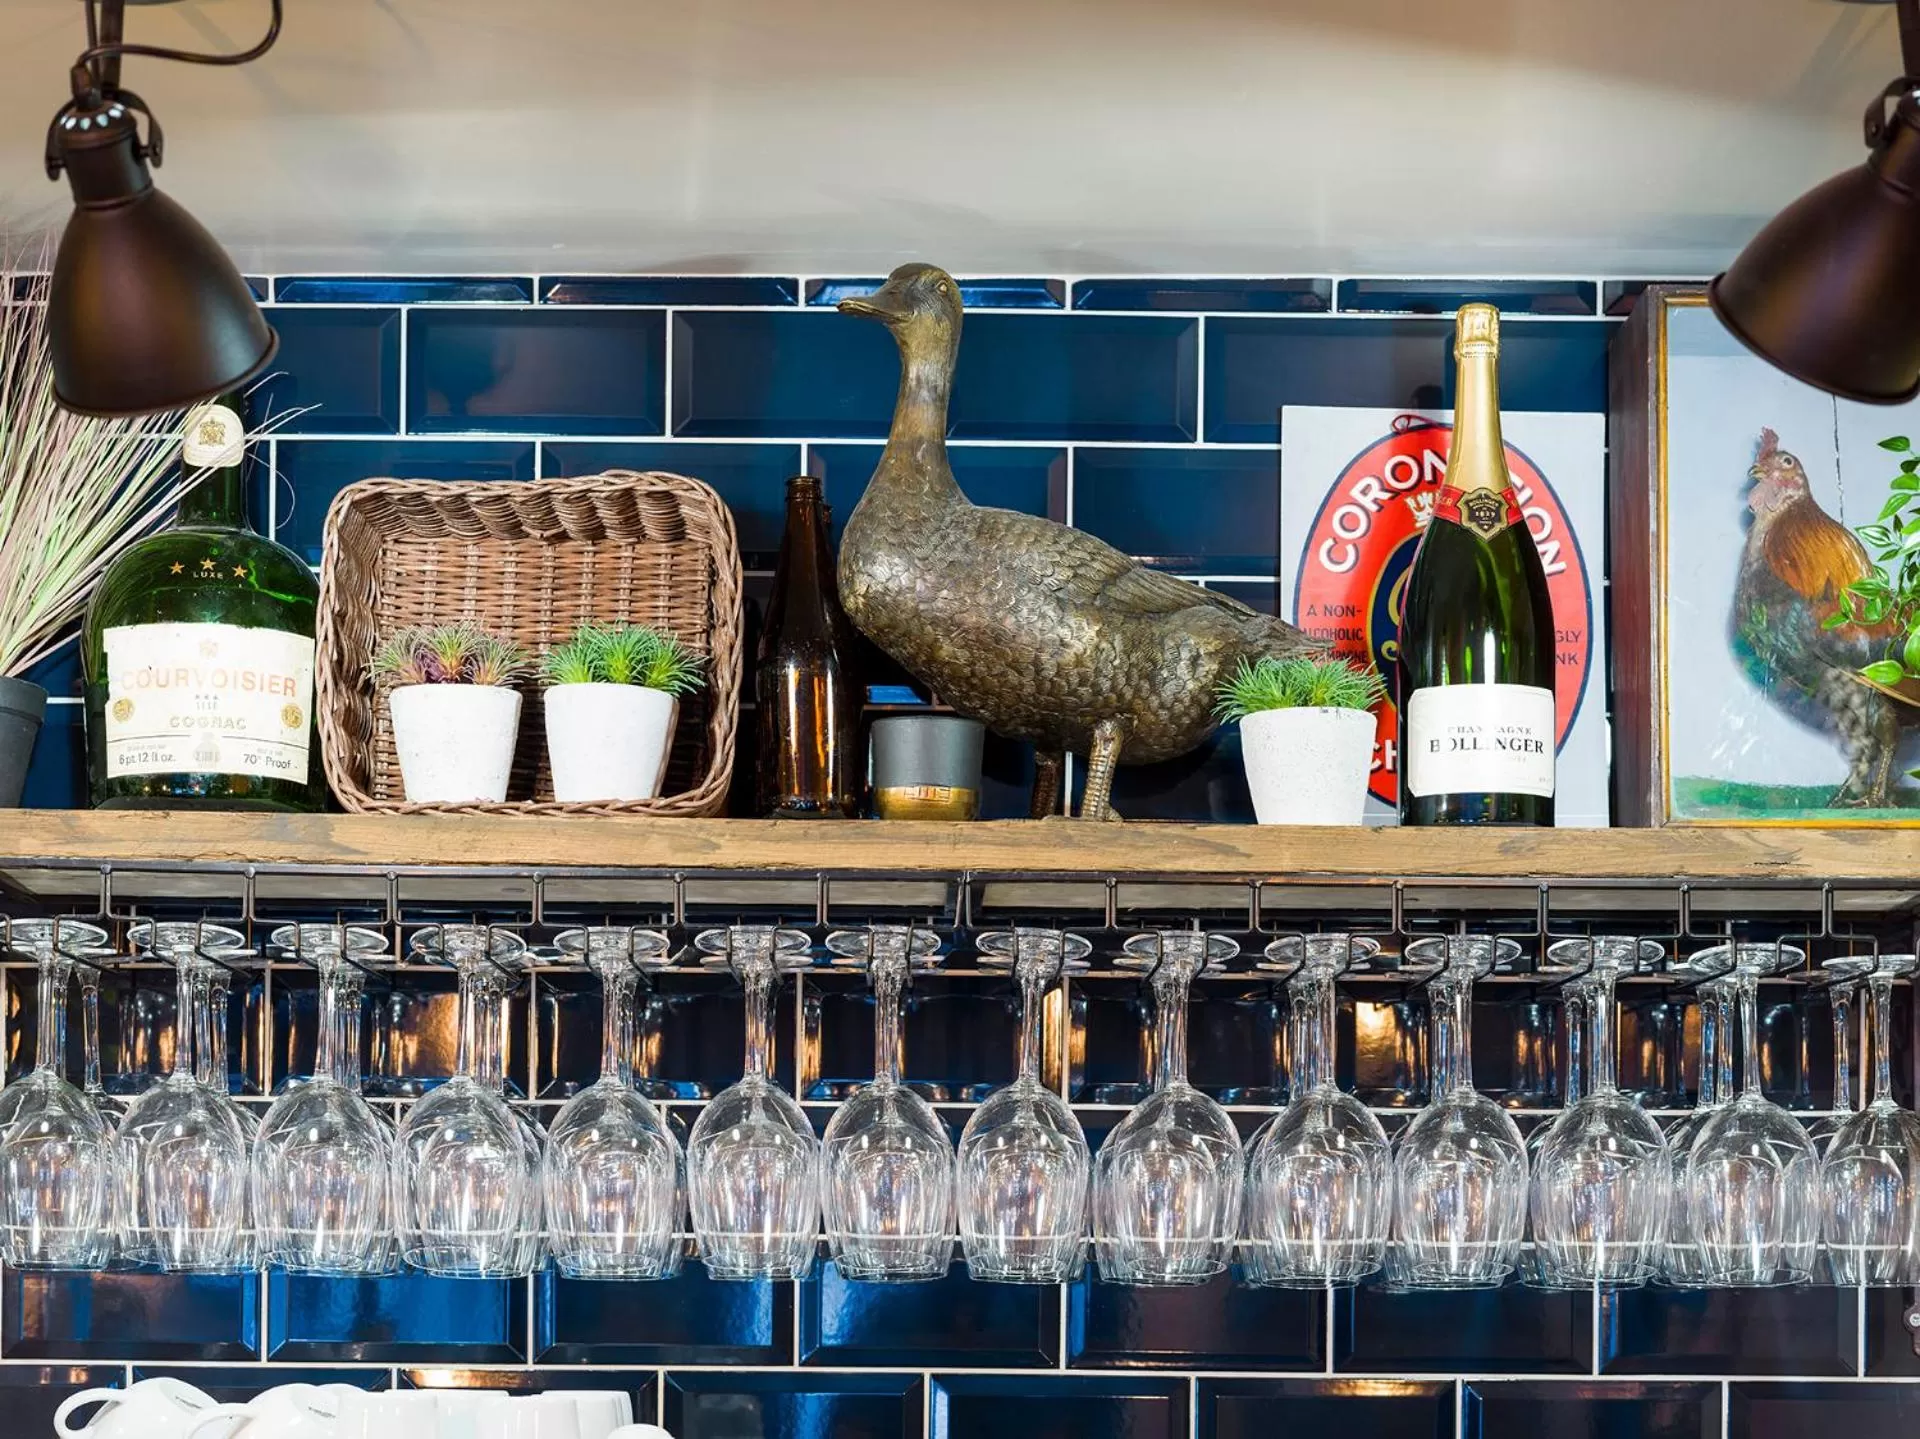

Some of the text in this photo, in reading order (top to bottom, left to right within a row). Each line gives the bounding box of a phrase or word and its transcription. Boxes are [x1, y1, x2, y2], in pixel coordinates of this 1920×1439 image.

[1318, 448, 1568, 577] CORONION
[193, 571, 224, 579] LUXE
[1307, 604, 1362, 618] A NON-
[121, 669, 297, 698] COURVOISIER
[169, 716, 247, 731] COGNAC
[1430, 736, 1544, 754] BOLLNGER
[118, 754, 125, 765] 6
[138, 752, 149, 764] 12
